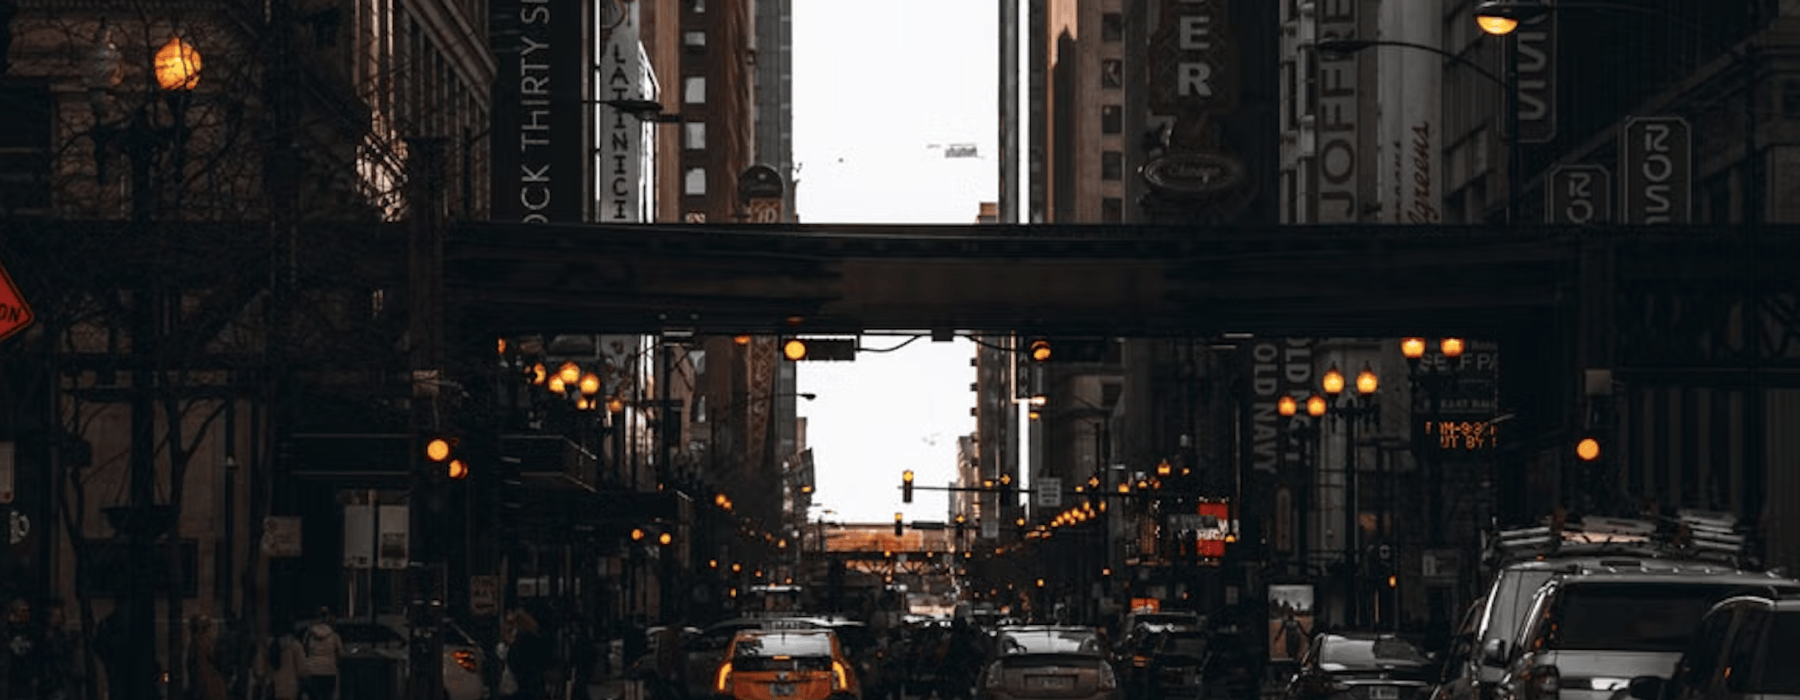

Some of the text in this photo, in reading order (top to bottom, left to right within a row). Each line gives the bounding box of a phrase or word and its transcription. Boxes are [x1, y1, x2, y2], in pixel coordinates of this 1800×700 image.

[520, 0, 550, 24] S
[1178, 0, 1212, 96] ER
[520, 36, 550, 151] THIRTY
[609, 44, 629, 219] LATINICI
[1566, 172, 1594, 224] RO
[1253, 343, 1278, 474] OLD NAVY
[1419, 353, 1473, 373] SEF
